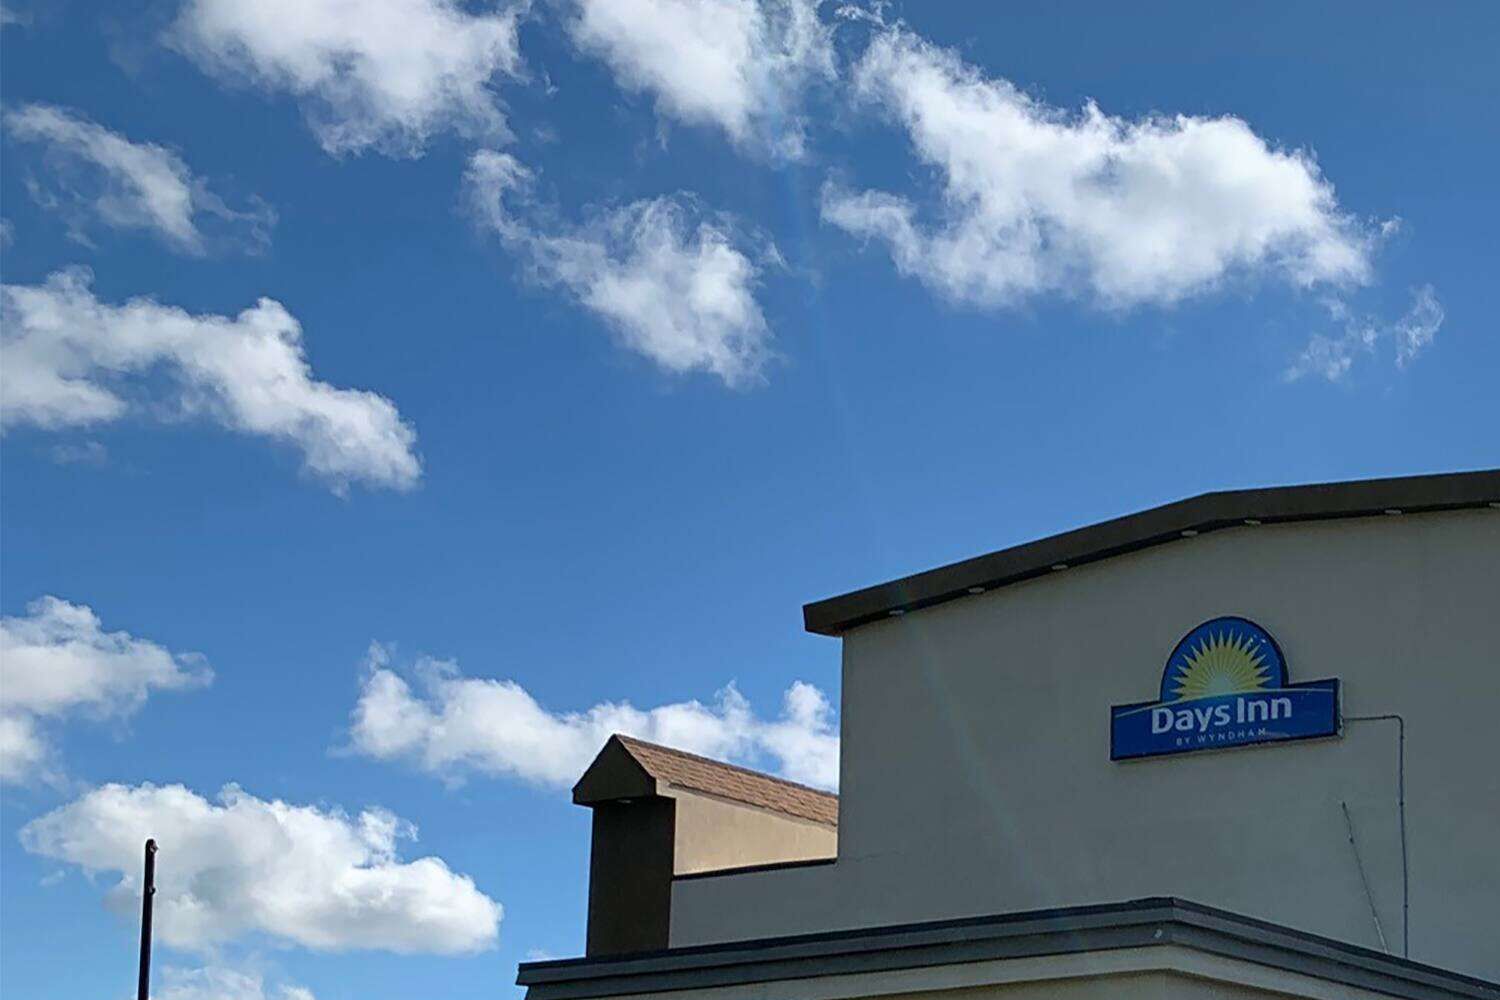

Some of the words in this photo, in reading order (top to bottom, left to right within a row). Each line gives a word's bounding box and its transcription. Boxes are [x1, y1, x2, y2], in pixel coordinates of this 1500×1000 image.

[1152, 705, 1231, 734] Days
[1237, 697, 1292, 723] Inn
[1176, 736, 1191, 746] BY
[1197, 728, 1266, 743] WYNDHAM
